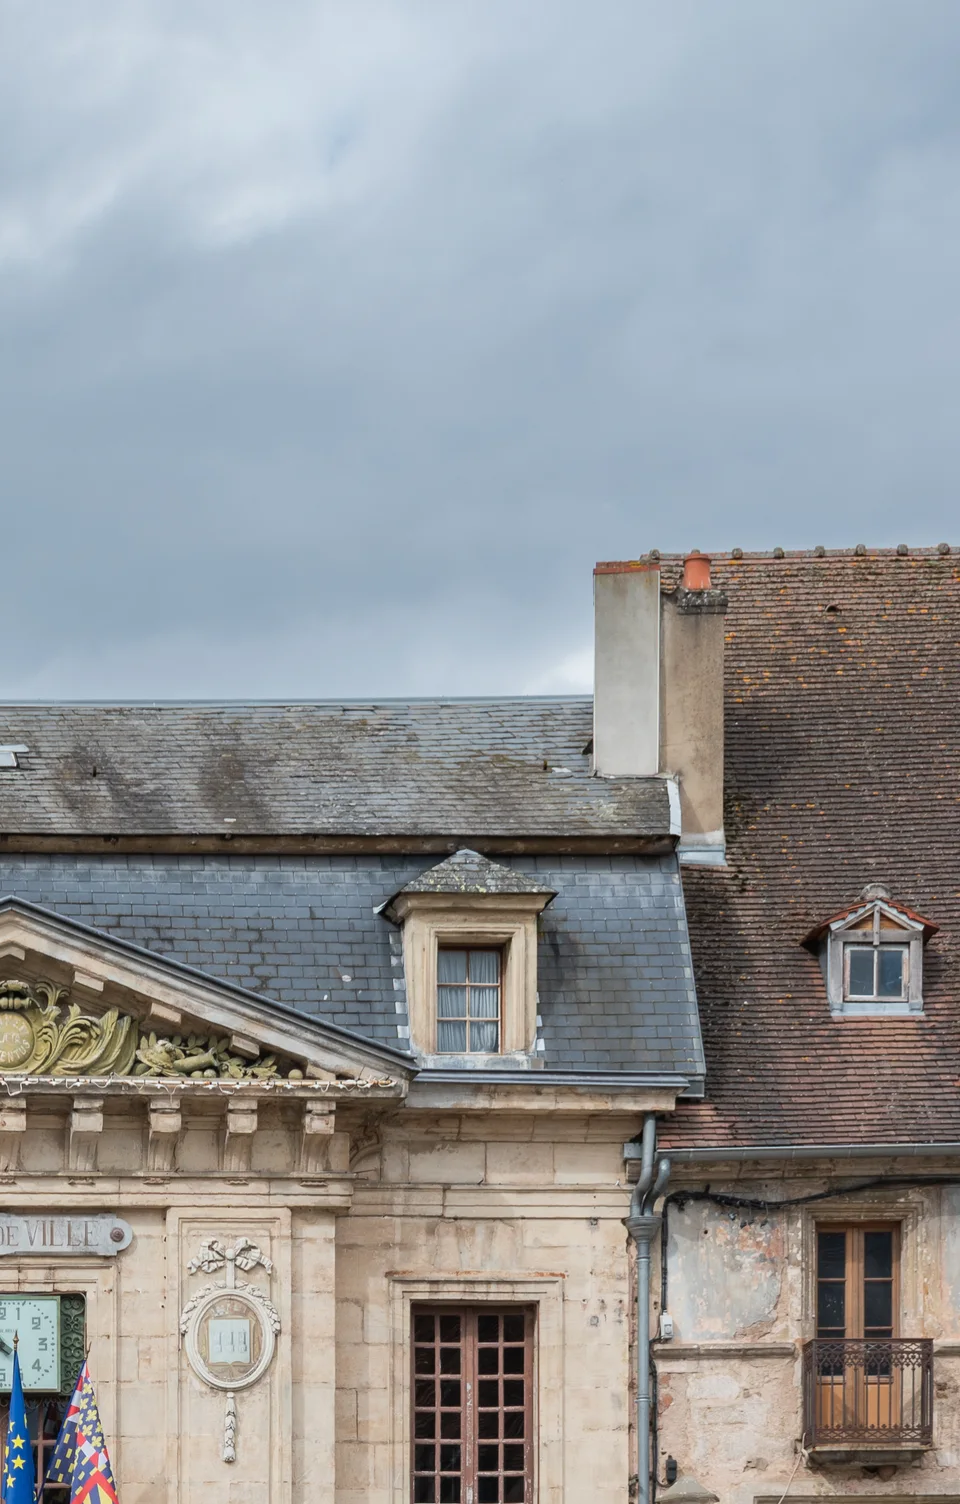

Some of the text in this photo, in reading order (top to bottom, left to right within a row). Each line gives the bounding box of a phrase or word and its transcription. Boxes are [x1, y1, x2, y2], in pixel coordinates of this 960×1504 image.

[24, 1219, 99, 1246] VILLE
[16, 1307, 20, 1320] 1
[31, 1316, 41, 1330] 2
[38, 1337, 48, 1351] 3
[31, 1358, 42, 1372] 4
